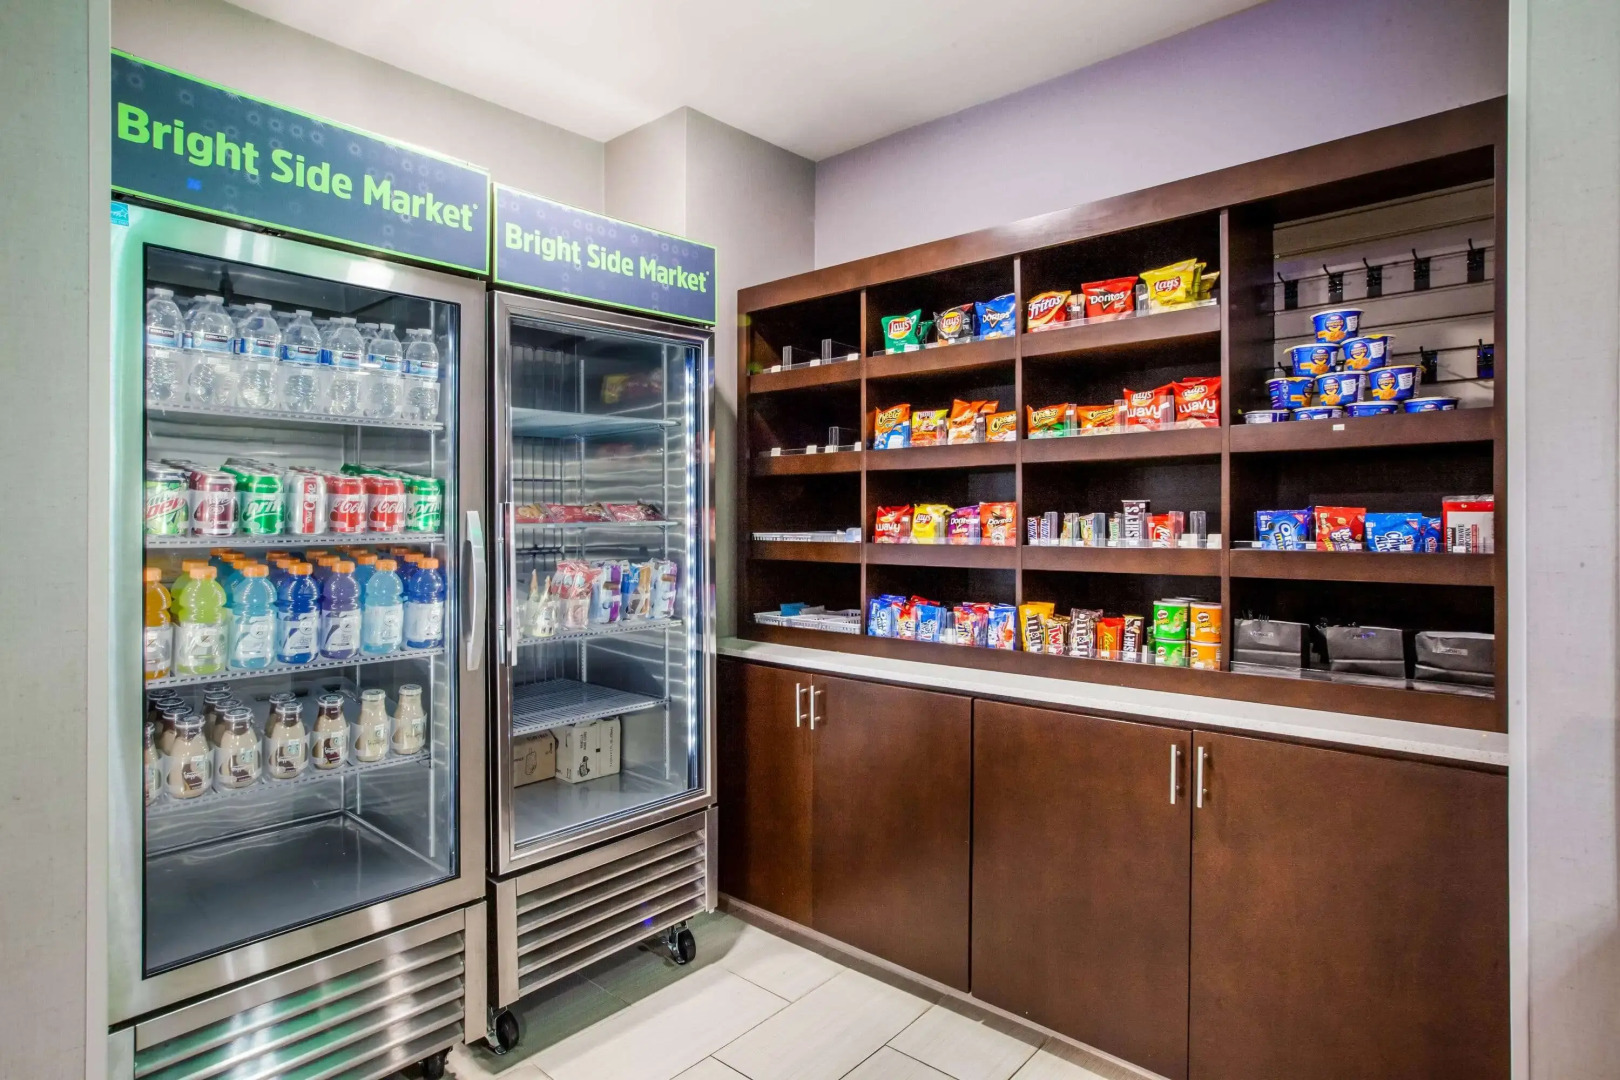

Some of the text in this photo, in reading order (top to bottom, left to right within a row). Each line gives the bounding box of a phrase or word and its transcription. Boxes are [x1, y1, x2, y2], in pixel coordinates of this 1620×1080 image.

[117, 101, 474, 232] Bright Side Market
[505, 222, 707, 293] Bright Side Market
[1027, 295, 1062, 320] Fritos
[1089, 291, 1125, 305] Doritos
